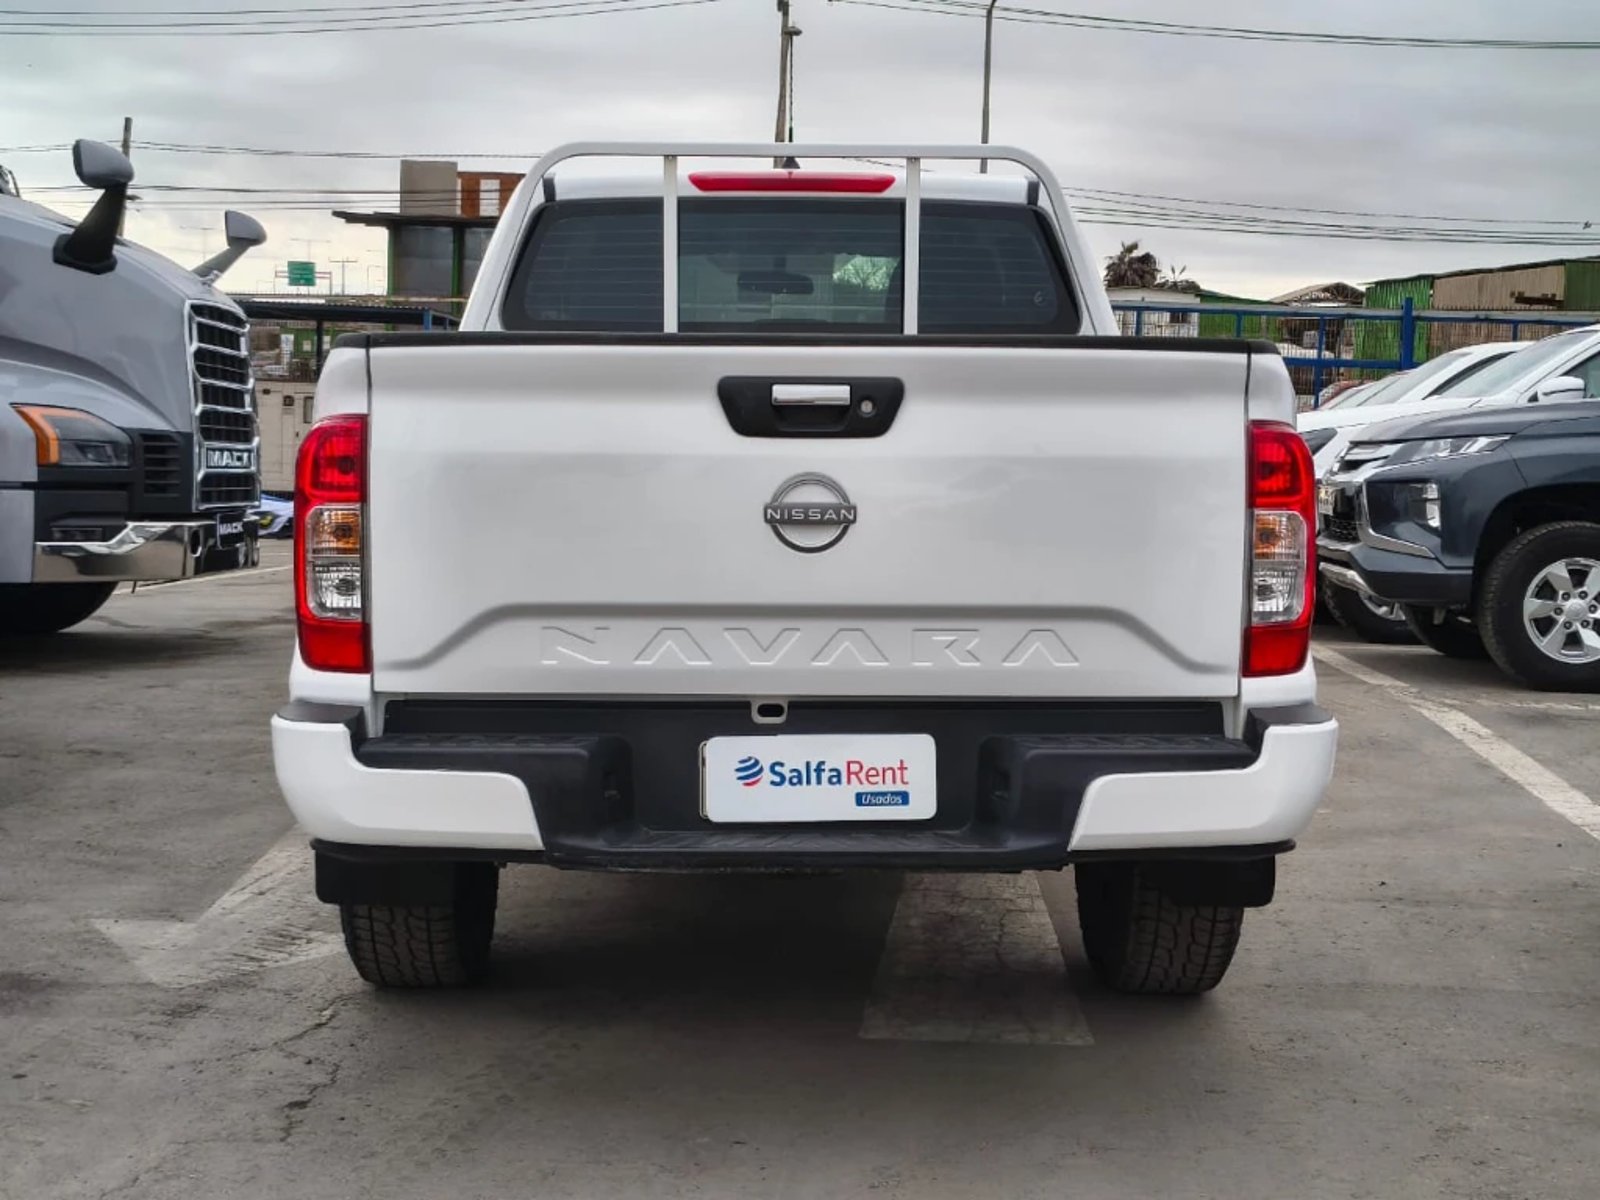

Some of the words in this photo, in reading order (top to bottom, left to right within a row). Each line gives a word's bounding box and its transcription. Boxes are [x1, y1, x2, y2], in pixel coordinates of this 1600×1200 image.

[207, 450, 250, 467] MACK
[766, 508, 855, 521] NISSAN
[219, 522, 243, 534] MACK
[541, 627, 1080, 667] NAVARA
[769, 759, 909, 787] SalfaRent
[861, 793, 903, 805] Usados
